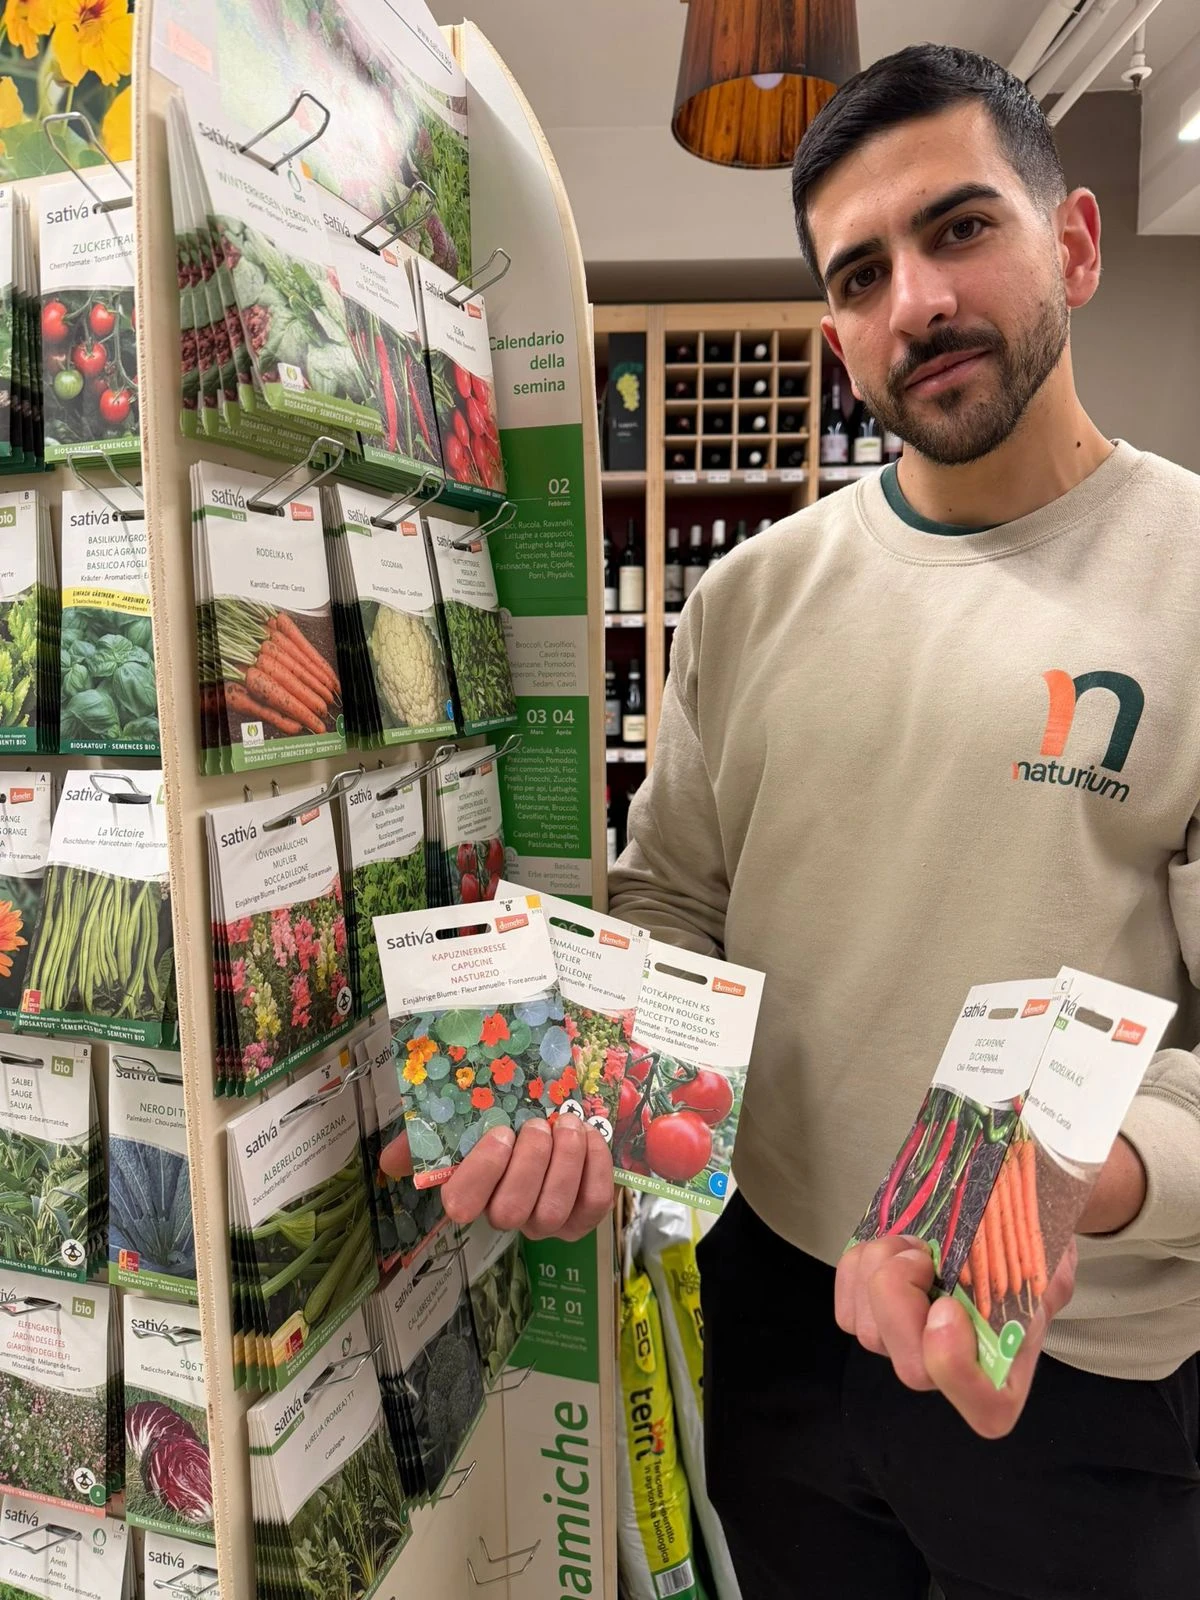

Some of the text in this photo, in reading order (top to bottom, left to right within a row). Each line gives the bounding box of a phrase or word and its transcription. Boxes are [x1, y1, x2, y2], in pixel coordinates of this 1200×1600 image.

[47, 199, 88, 224] sativa
[323, 213, 351, 237] sativa
[49, 259, 90, 270] Cherrytomate
[94, 253, 114, 263] Tomate
[489, 330, 564, 351] Calendario
[530, 353, 565, 369] della
[514, 378, 565, 395] semina
[548, 478, 570, 494] 02
[24, 492, 29, 500] B
[212, 486, 246, 509] sativa
[70, 507, 110, 527] sativa
[347, 507, 371, 525] sativa
[88, 535, 128, 544] BASILIKUM
[86, 549, 112, 557] BASILIC
[121, 547, 147, 555] GRAND
[256, 548, 286, 559] RODELIKA
[87, 562, 118, 570] BASILICO
[81, 572, 140, 582] Kräuter Aromatiques
[527, 709, 575, 724] 03 04
[40, 774, 46, 782] A
[1011, 761, 1130, 802] naturium
[65, 784, 103, 802] sativa
[350, 784, 372, 806] sativa
[97, 827, 145, 838] La Victoire
[221, 818, 257, 848] sativa
[255, 837, 308, 861] LÖWENMÄULCHEN
[272, 855, 298, 869] MUFLIER
[264, 863, 309, 887] BOCCA DI LEONE
[499, 917, 525, 929] demeter
[386, 925, 435, 950] sativa
[601, 933, 627, 946] demeter
[431, 942, 507, 962] KAPUZINERKRESSE
[550, 937, 602, 960] ENMÄULCHEN
[451, 958, 494, 972] CAPUCINE
[559, 964, 593, 981] DI LEONE
[451, 969, 500, 985] NASTURZIO
[1061, 980, 1067, 991] C
[402, 993, 437, 1006] Einjährige
[437, 989, 458, 999] Blume
[461, 984, 478, 994] Fleur
[478, 981, 505, 991] annuelle
[523, 974, 547, 983] annuale
[560, 977, 626, 1001] annuelle Fiore annuale
[715, 982, 742, 994] demeter
[642, 985, 710, 1012] ROTKÄPPCHEN KS
[637, 995, 716, 1025] HAPERON ROUGE KS
[962, 999, 989, 1018] sativa
[19, 1020, 55, 1029] BIOSAATGUT
[60, 1023, 94, 1032] SEMENCES
[107, 1031, 133, 1040] SEMENTI
[635, 1006, 720, 1039] PPUCCETTO ROSSO KS
[634, 1026, 666, 1041] Pomodoro
[674, 1038, 699, 1052] balcone
[54, 1061, 70, 1074] bio
[11, 1077, 33, 1087] SALBEI
[11, 1088, 33, 1098] SAUGE
[9, 1101, 33, 1110] SALVIA
[126, 1114, 170, 1127] Palmkohl Chou
[245, 1119, 278, 1159] sativa
[264, 1114, 347, 1184] ALBERELLO DI SARZANA
[717, 1180, 724, 1188] C
[648, 1180, 662, 1190] BIO
[666, 1186, 697, 1202] SEMENTI
[698, 1196, 712, 1207] BIO
[539, 1263, 579, 1282] 10 11
[118, 1276, 154, 1288] BIOSAATGUT
[74, 1302, 92, 1315] bio
[540, 1296, 581, 1315] 12 01
[18, 1320, 61, 1335] ELFENGARTEN
[131, 1318, 169, 1332] sativa
[12, 1331, 65, 1348] JARDIN DES ELFES
[7, 1342, 38, 1355] GIARDINO
[39, 1349, 57, 1358] DEGLI
[274, 1389, 302, 1436] sativa
[5, 1508, 39, 1527] sativa
[135, 1517, 171, 1530] BIOSAATGUT
[119, 1524, 125, 1532] A
[55, 1545, 66, 1555] Dill
[50, 1557, 68, 1568] Aneth
[148, 1550, 185, 1569] sativa
[49, 1568, 66, 1580] Aneto
